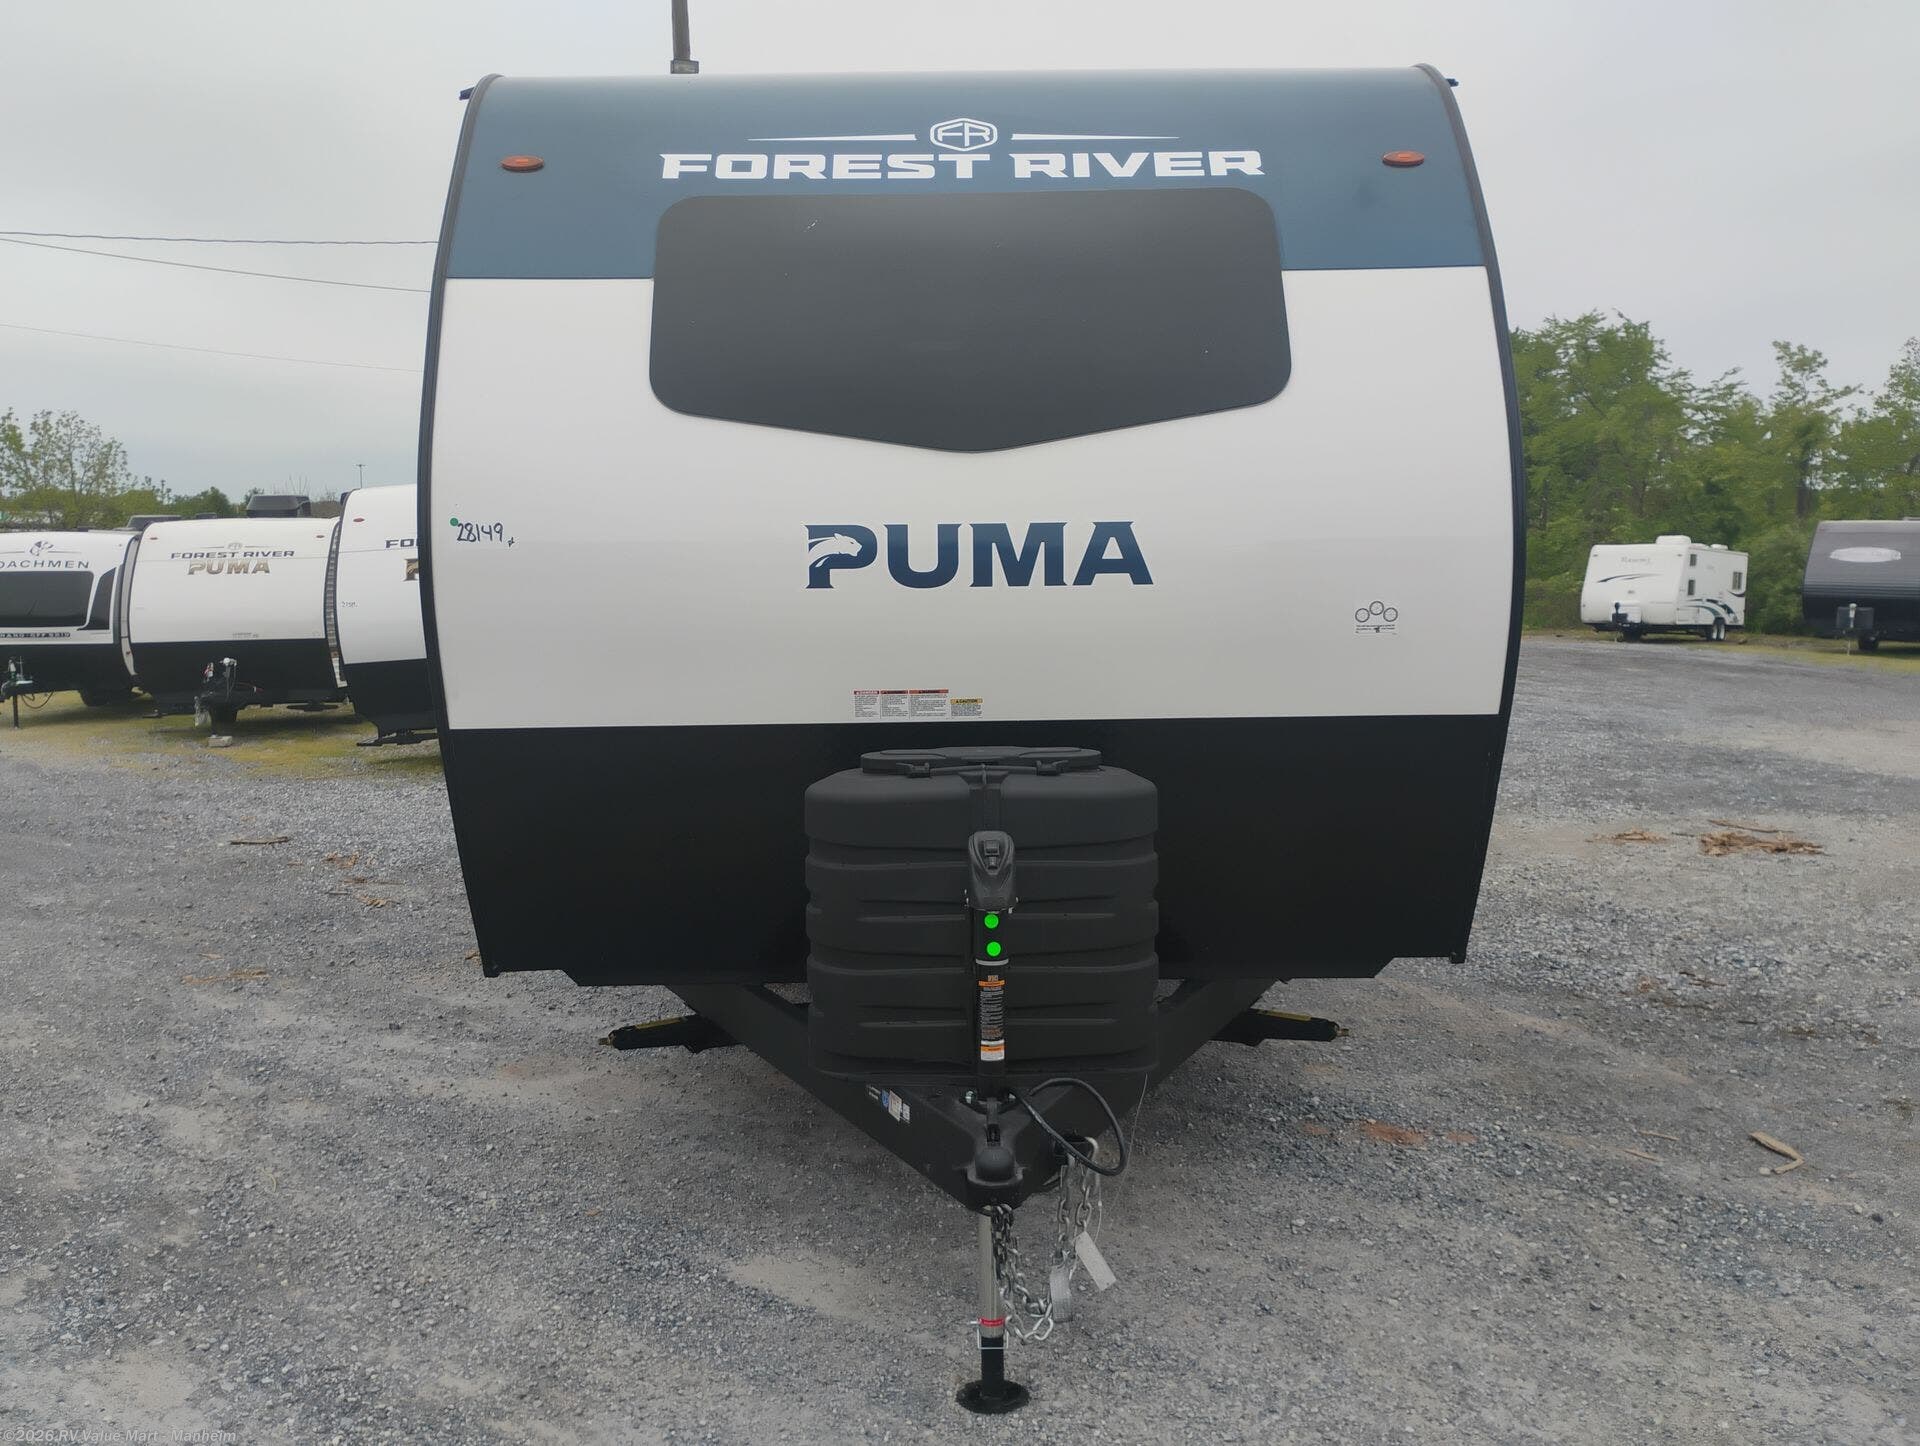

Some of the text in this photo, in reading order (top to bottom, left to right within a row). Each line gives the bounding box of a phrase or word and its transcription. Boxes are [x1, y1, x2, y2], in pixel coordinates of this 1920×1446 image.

[659, 150, 1265, 180] FOREST RIVER
[456, 522, 504, 543] 28149
[385, 538, 419, 549] FO
[171, 550, 295, 559] FOREST RIVER
[805, 521, 1154, 589] PUMA
[187, 559, 270, 576] PUMA
